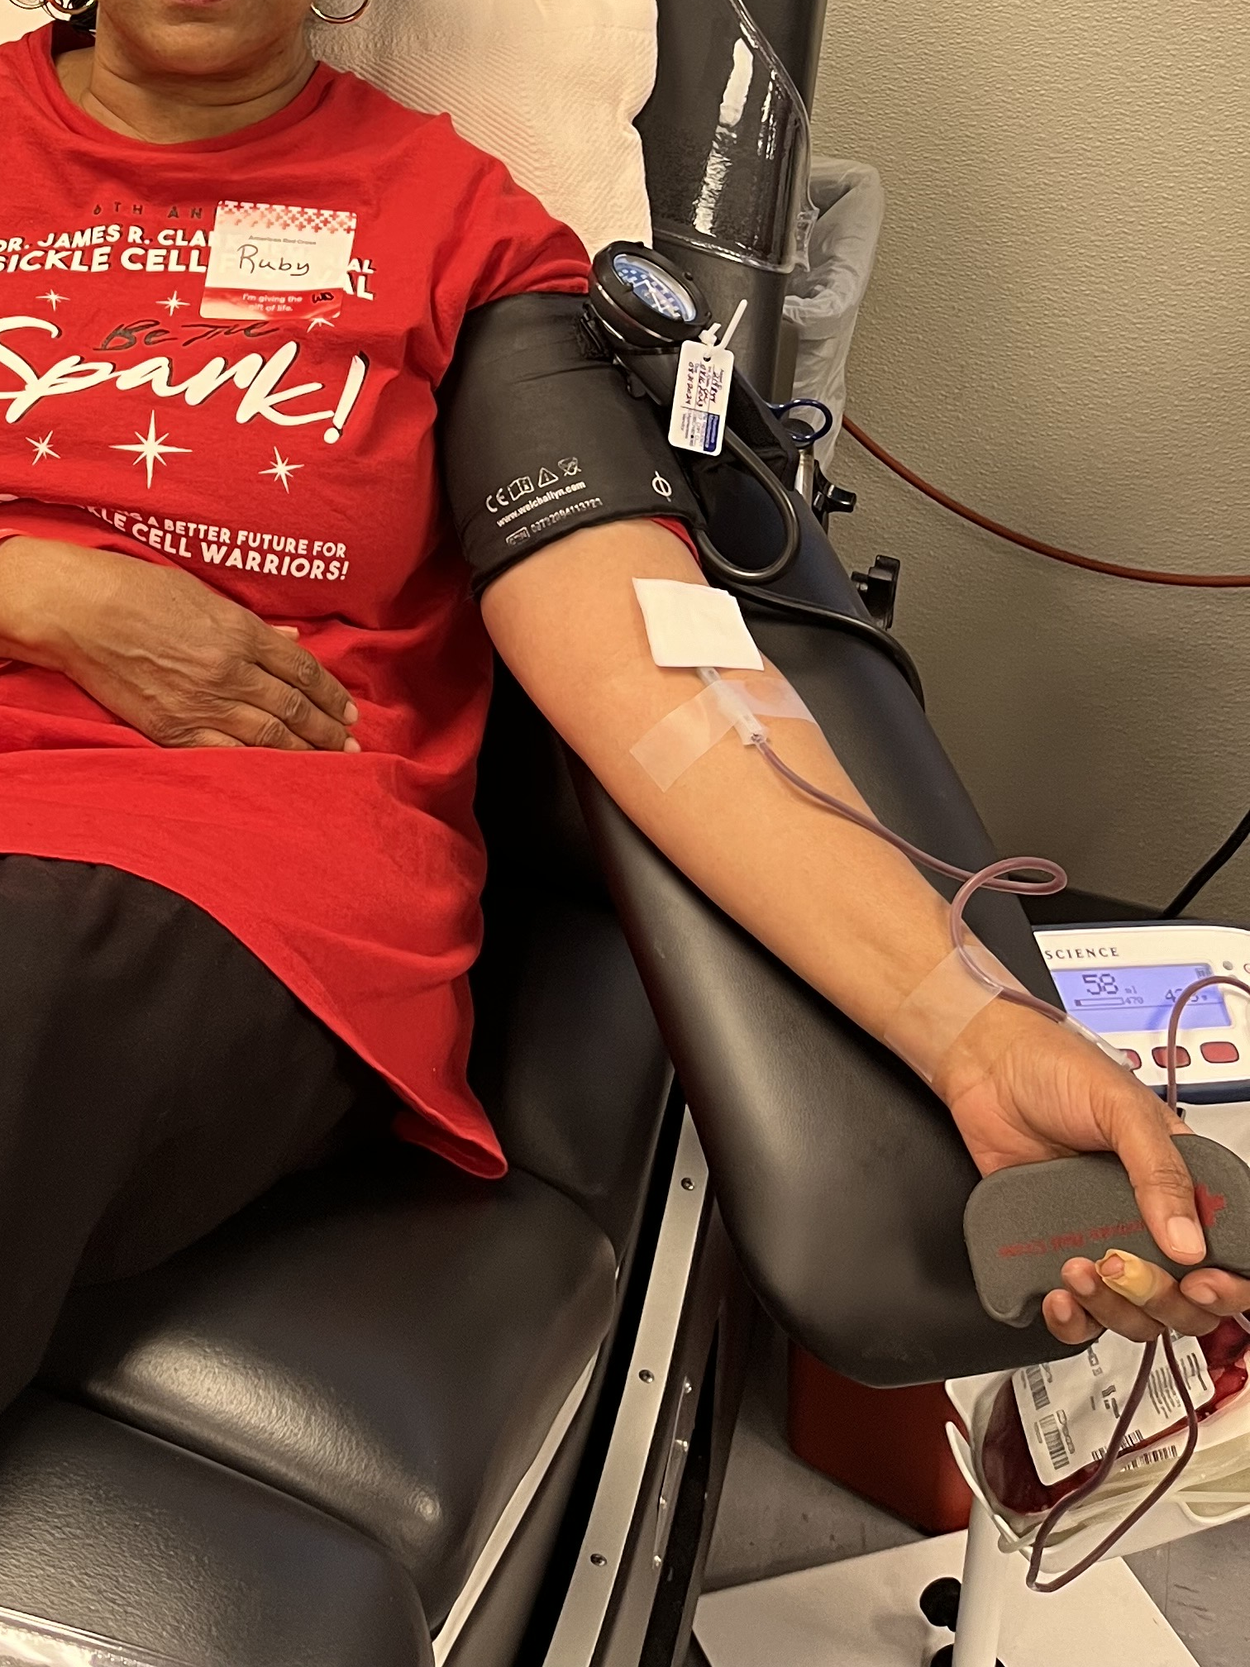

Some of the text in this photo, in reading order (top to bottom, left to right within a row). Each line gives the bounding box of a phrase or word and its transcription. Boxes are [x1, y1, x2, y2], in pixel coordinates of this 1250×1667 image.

[36, 224, 122, 249] JAMES
[127, 225, 151, 245] R.
[120, 246, 207, 273] CELL
[237, 243, 310, 277] Ruby
[258, 294, 285, 303] giving
[132, 522, 192, 559] CELL
[200, 541, 350, 581] WARRIORS!
[164, 518, 231, 544] BETTER
[236, 529, 308, 555] FUTURE
[312, 540, 347, 559] FOR
[1044, 947, 1120, 960] SCIENCE
[1081, 973, 1120, 996] 58
